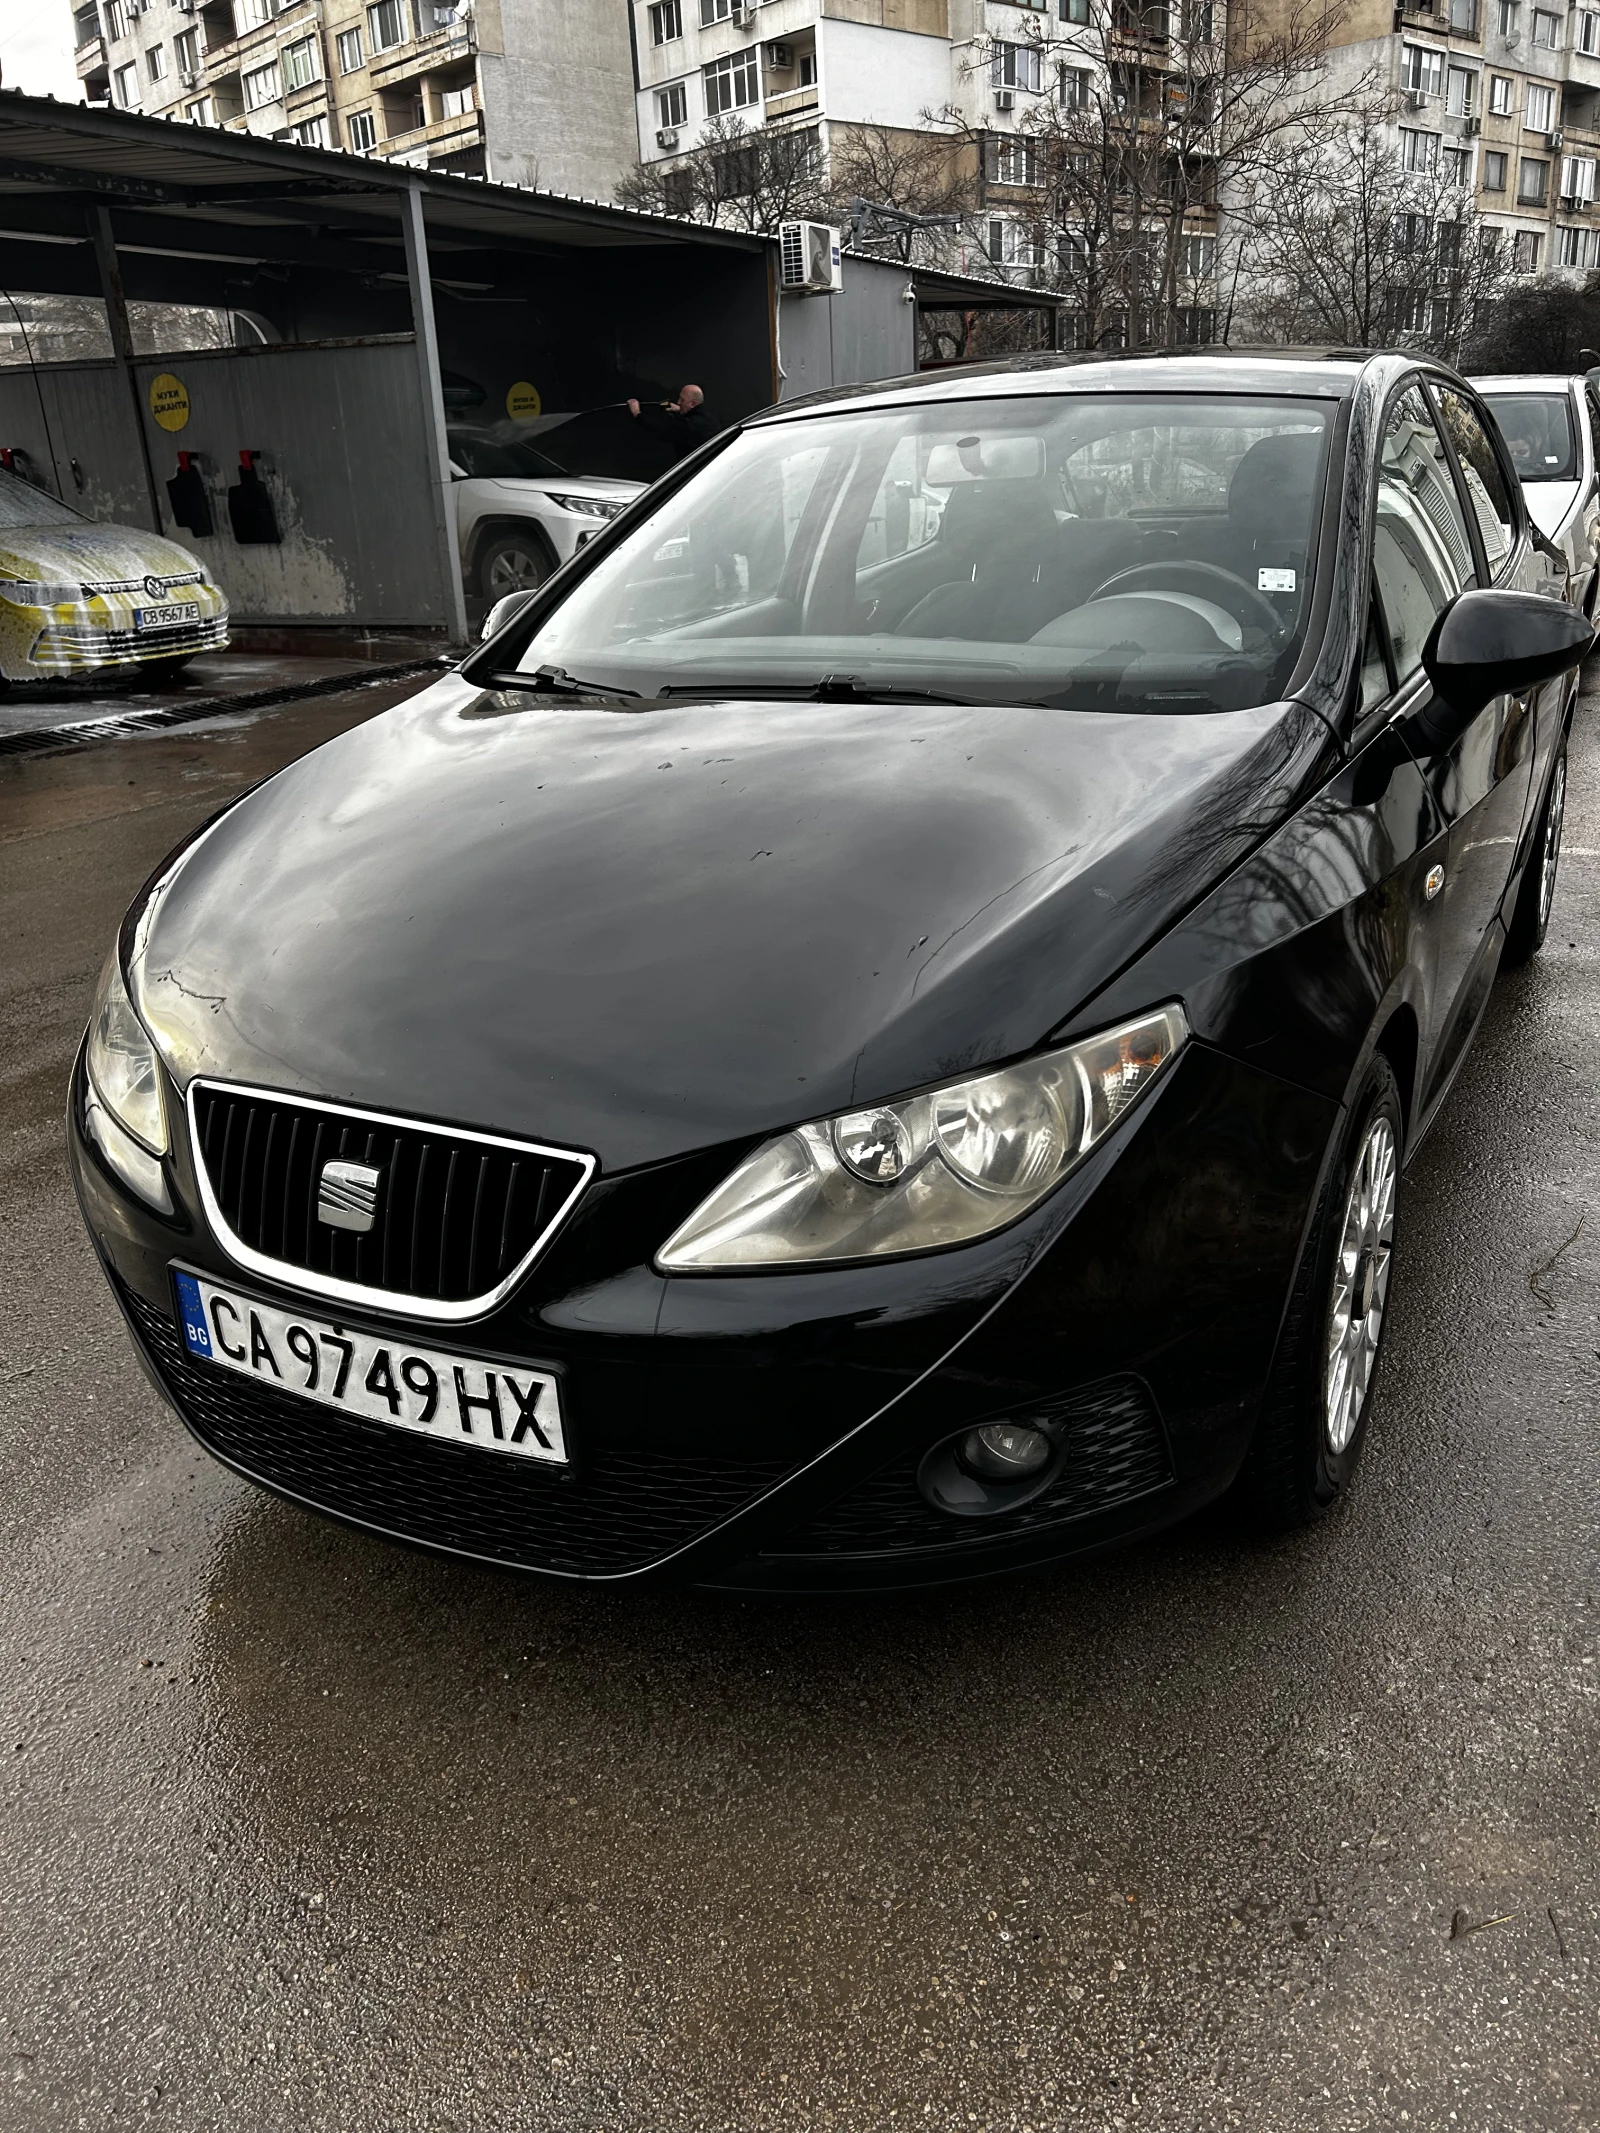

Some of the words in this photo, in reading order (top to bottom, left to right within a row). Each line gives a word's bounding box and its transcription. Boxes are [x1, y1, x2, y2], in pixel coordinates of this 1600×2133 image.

[153, 401, 188, 415] ДЖАНТИ
[142, 609, 159, 625] CB
[158, 606, 183, 623] 9567
[185, 604, 198, 619] AE
[186, 1322, 208, 1346] BG
[209, 1293, 285, 1380] CA
[286, 1322, 441, 1424] 9749
[451, 1363, 556, 1451] HX
